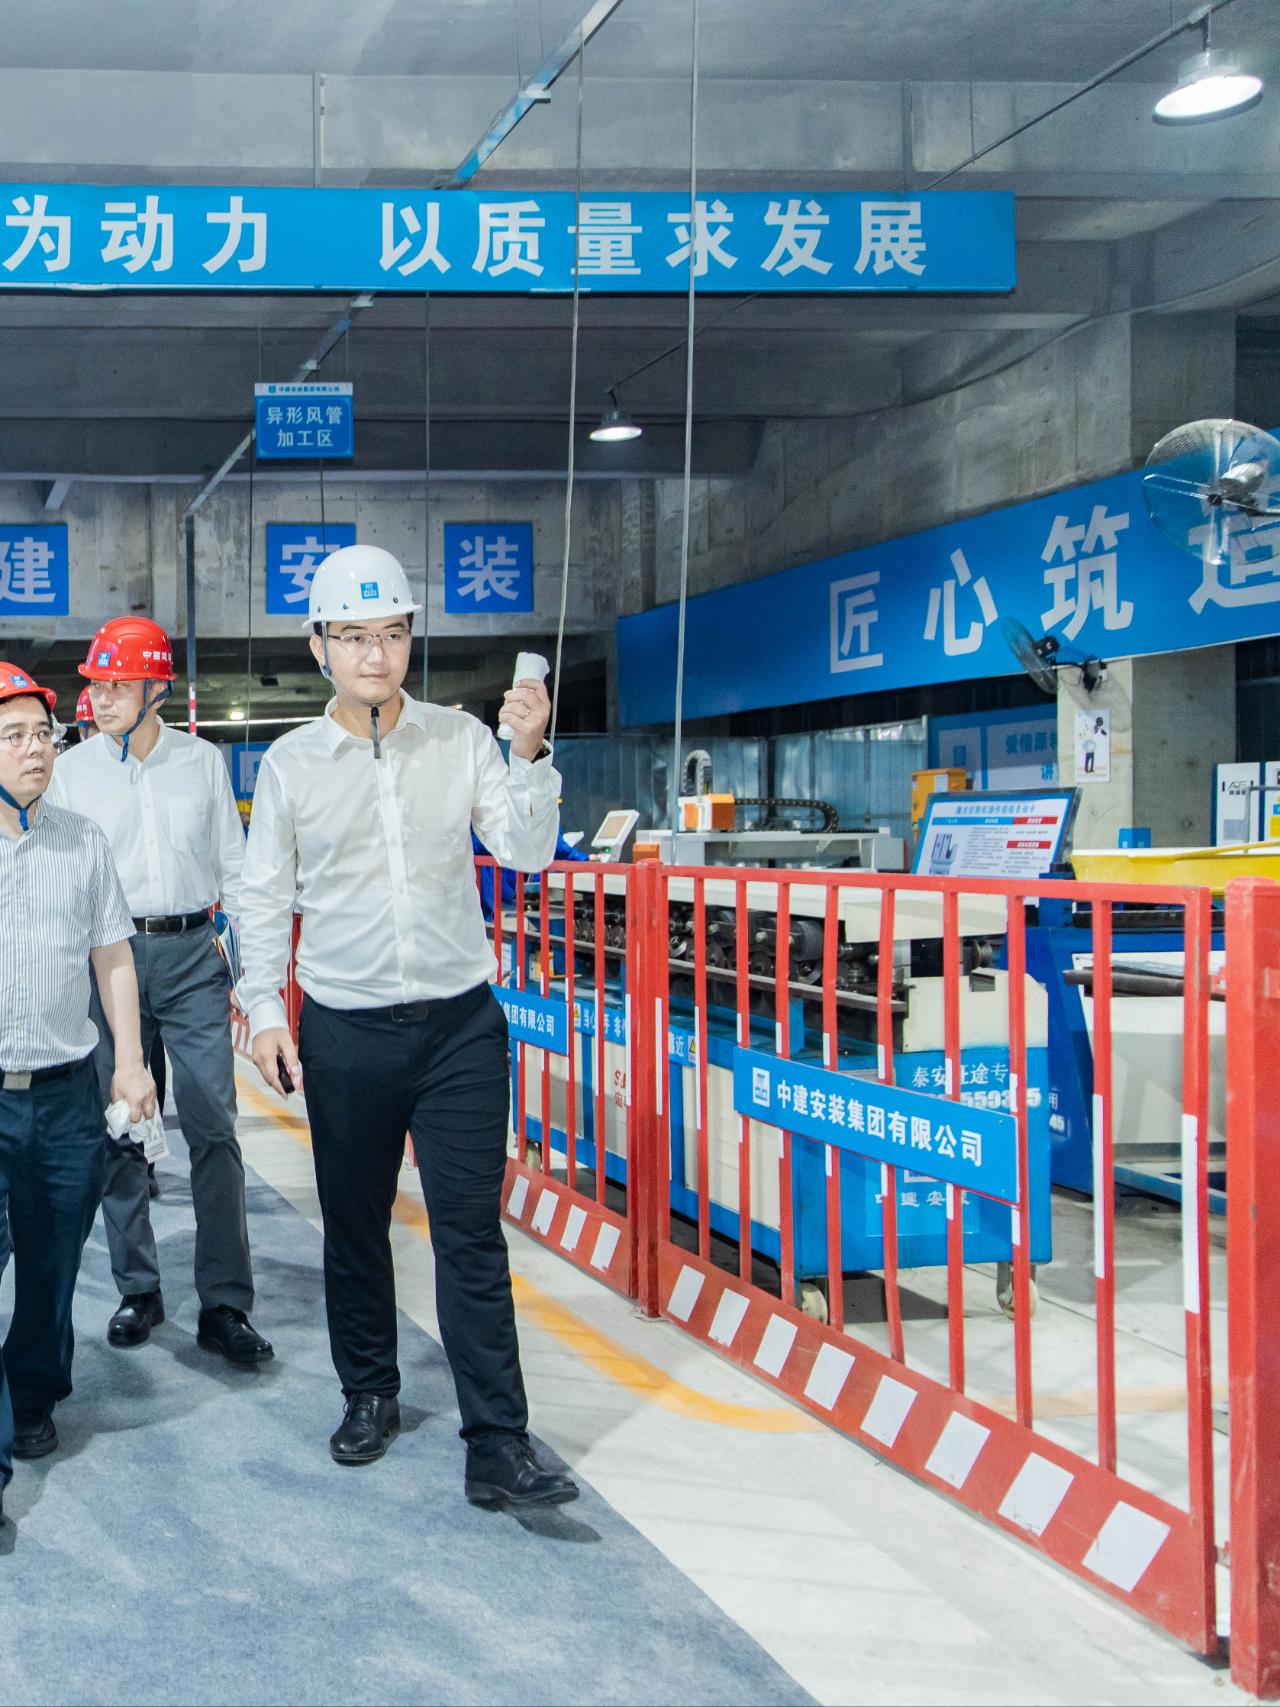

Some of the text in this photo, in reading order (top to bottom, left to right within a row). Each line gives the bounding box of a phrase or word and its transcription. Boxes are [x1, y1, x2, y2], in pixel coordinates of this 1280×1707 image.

[379, 200, 927, 279] 以质量求发展
[266, 406, 343, 425] 异形风管
[277, 429, 334, 447] 加工区
[457, 536, 520, 602] 装
[777, 1080, 983, 1168] 中建安装集团有限公司
